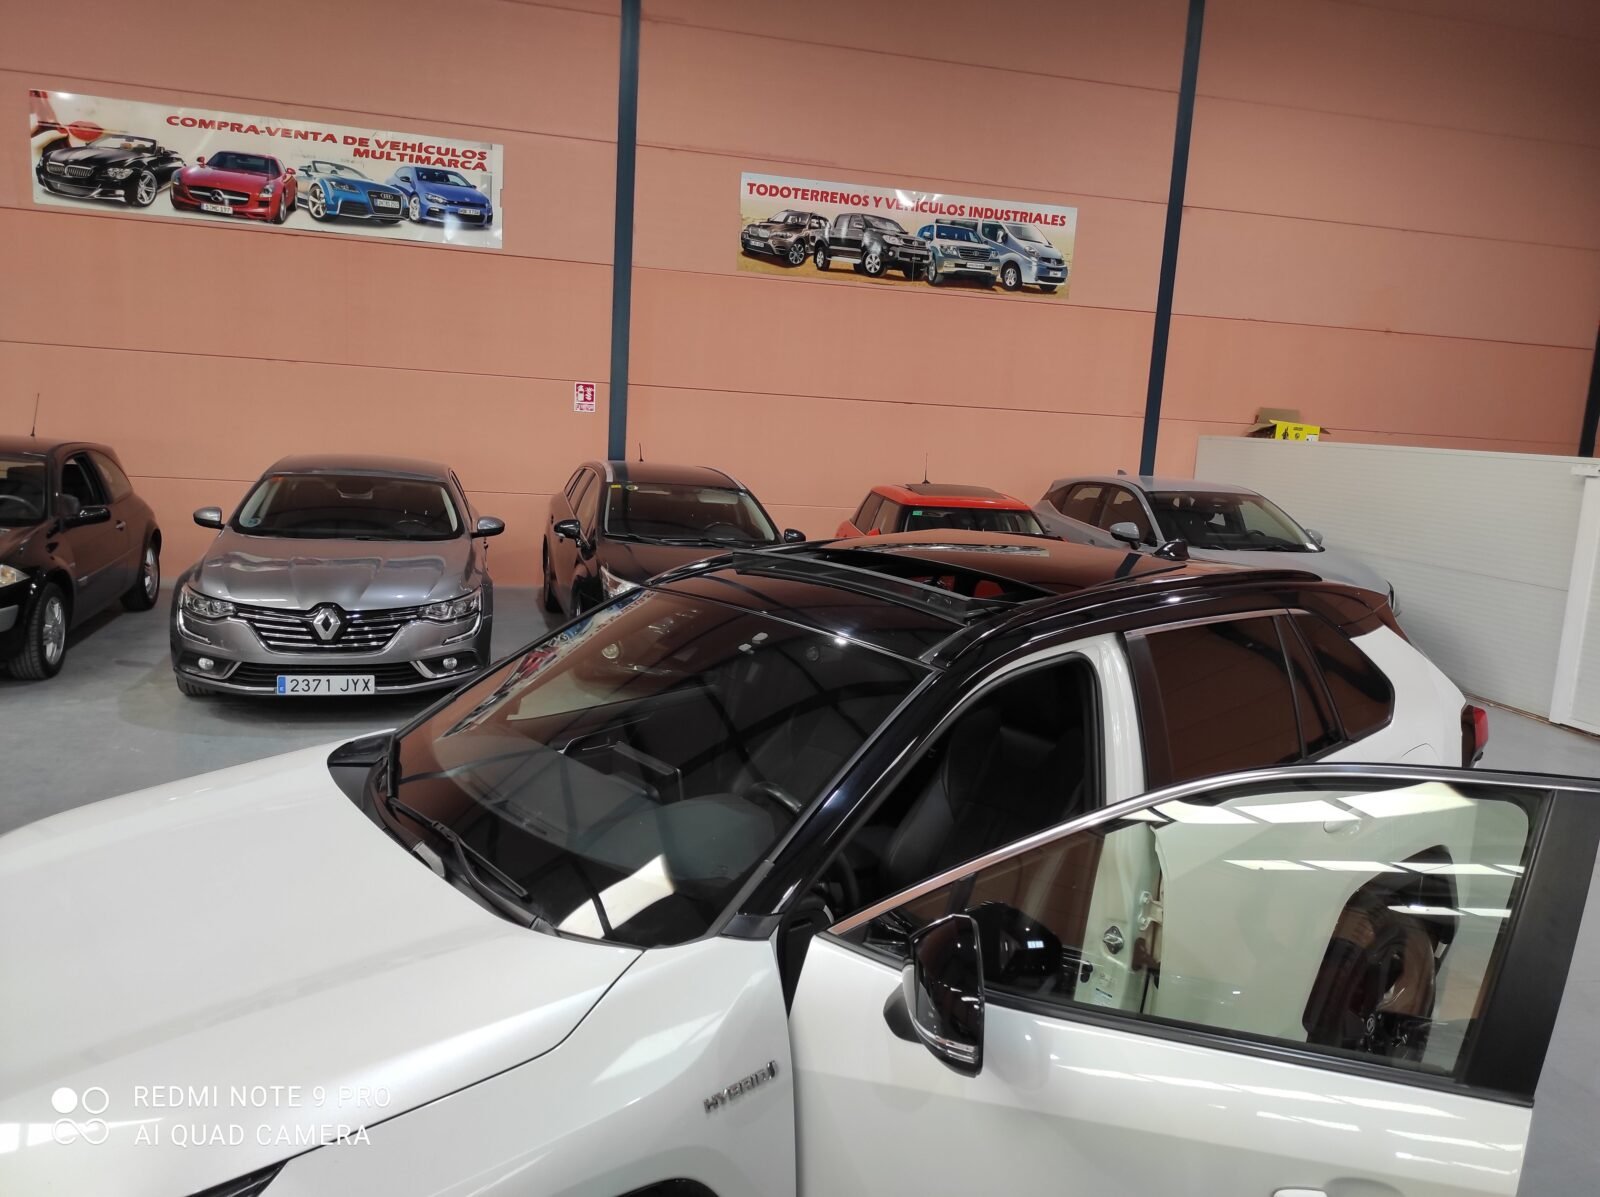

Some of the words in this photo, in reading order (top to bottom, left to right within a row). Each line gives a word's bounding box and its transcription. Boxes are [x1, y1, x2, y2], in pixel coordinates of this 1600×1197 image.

[166, 115, 338, 144] COMPRA-VENTA
[343, 135, 370, 148] DE
[375, 139, 488, 161] VEHÍCULOS
[353, 148, 488, 172] MULTIMARCA
[747, 182, 870, 207] TODOTERRENOS
[873, 196, 882, 208] Y
[969, 206, 1067, 227] INDUSTRIALES
[290, 678, 331, 692] 2371
[340, 678, 371, 692] JYX
[703, 1068, 768, 1114] HYBRID
